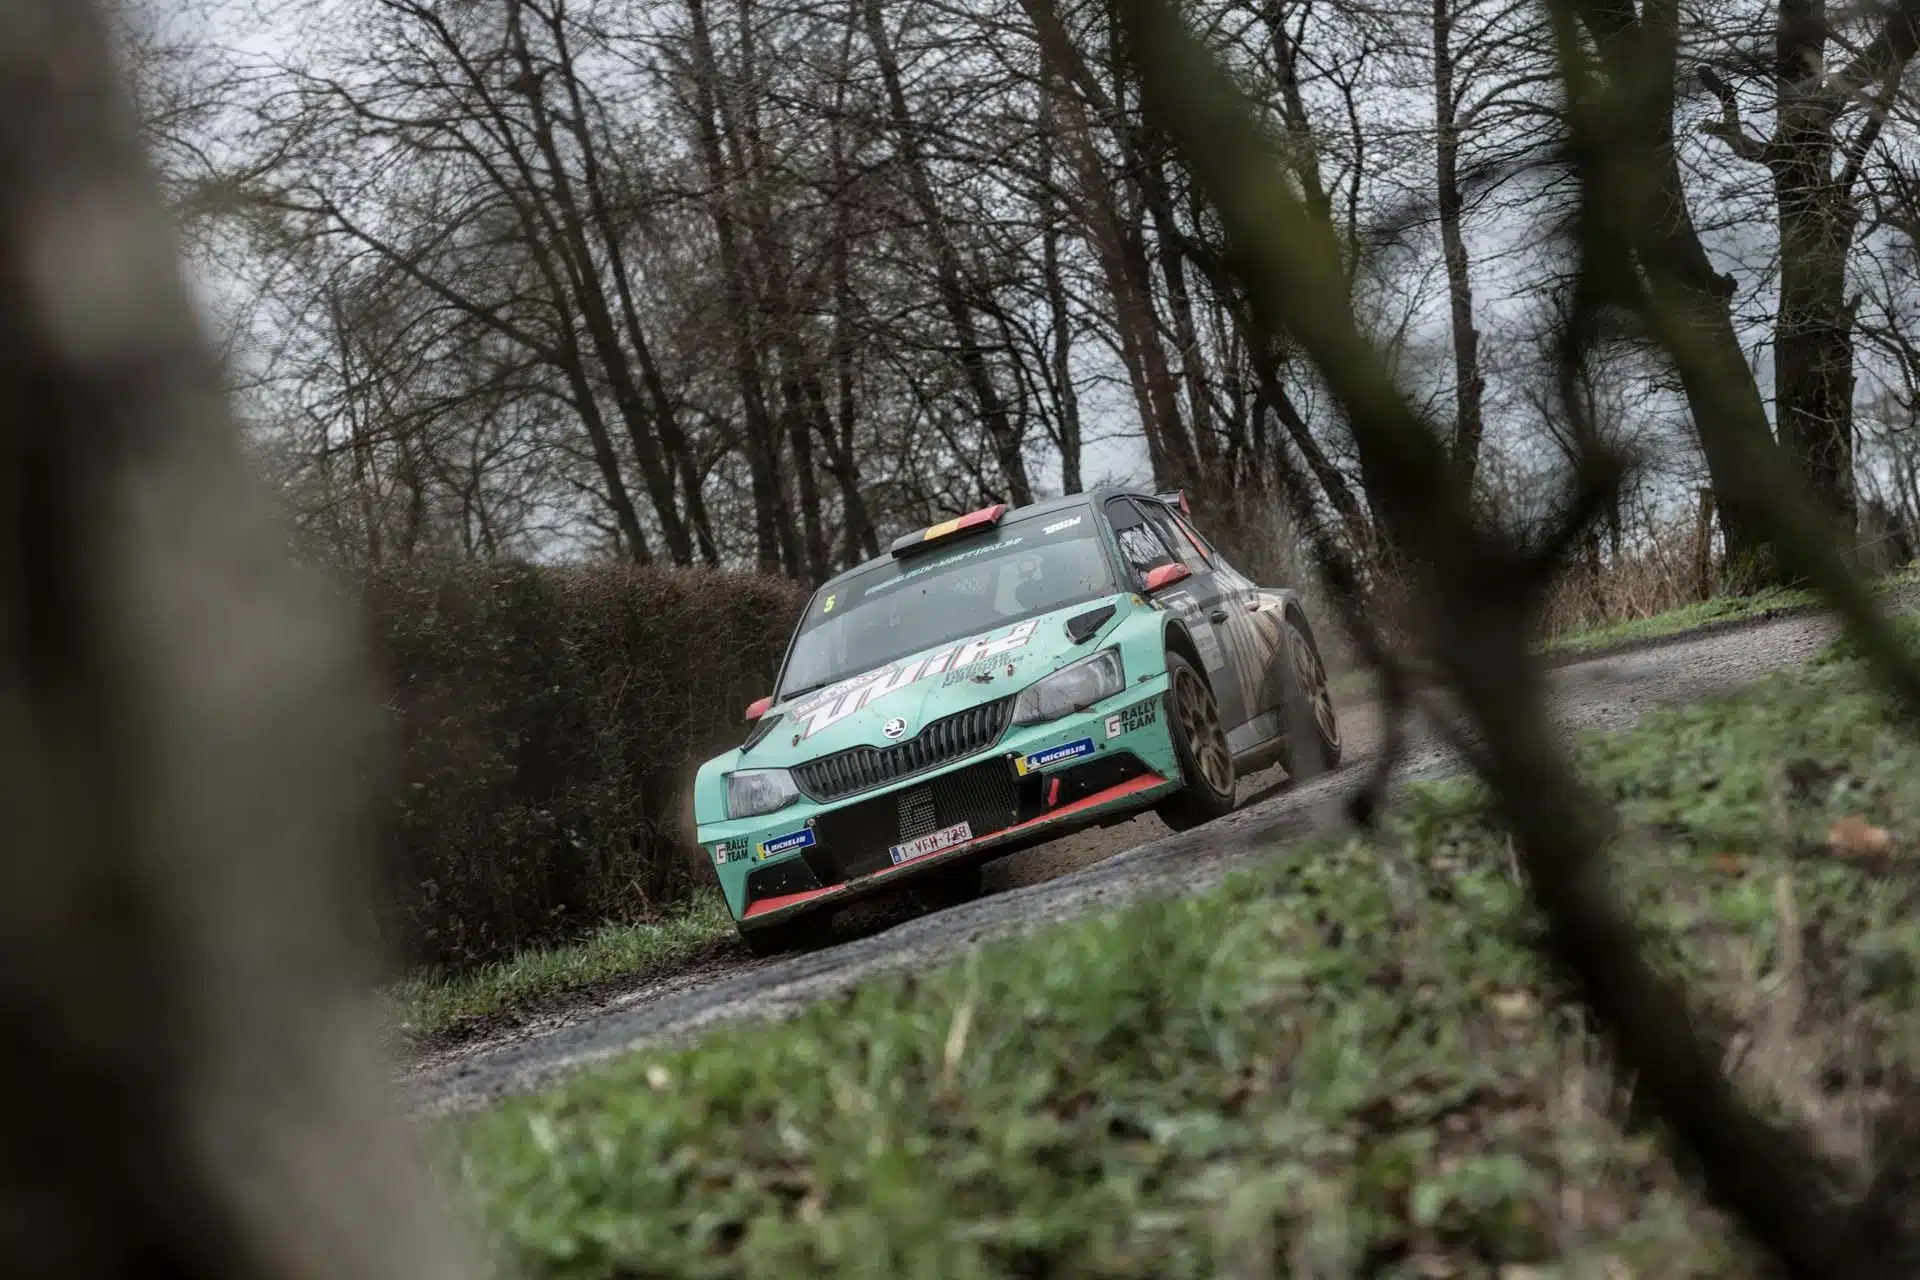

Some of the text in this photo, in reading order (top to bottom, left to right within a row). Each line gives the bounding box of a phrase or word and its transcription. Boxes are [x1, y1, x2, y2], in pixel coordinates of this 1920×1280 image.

[823, 594, 836, 613] 5
[1121, 699, 1157, 722] RALLY
[1121, 711, 1156, 733] TEAM
[1040, 743, 1086, 764] MICHELIN
[726, 837, 749, 851] RALLY
[771, 835, 806, 852] MICHELIN
[727, 849, 749, 862] TEAM
